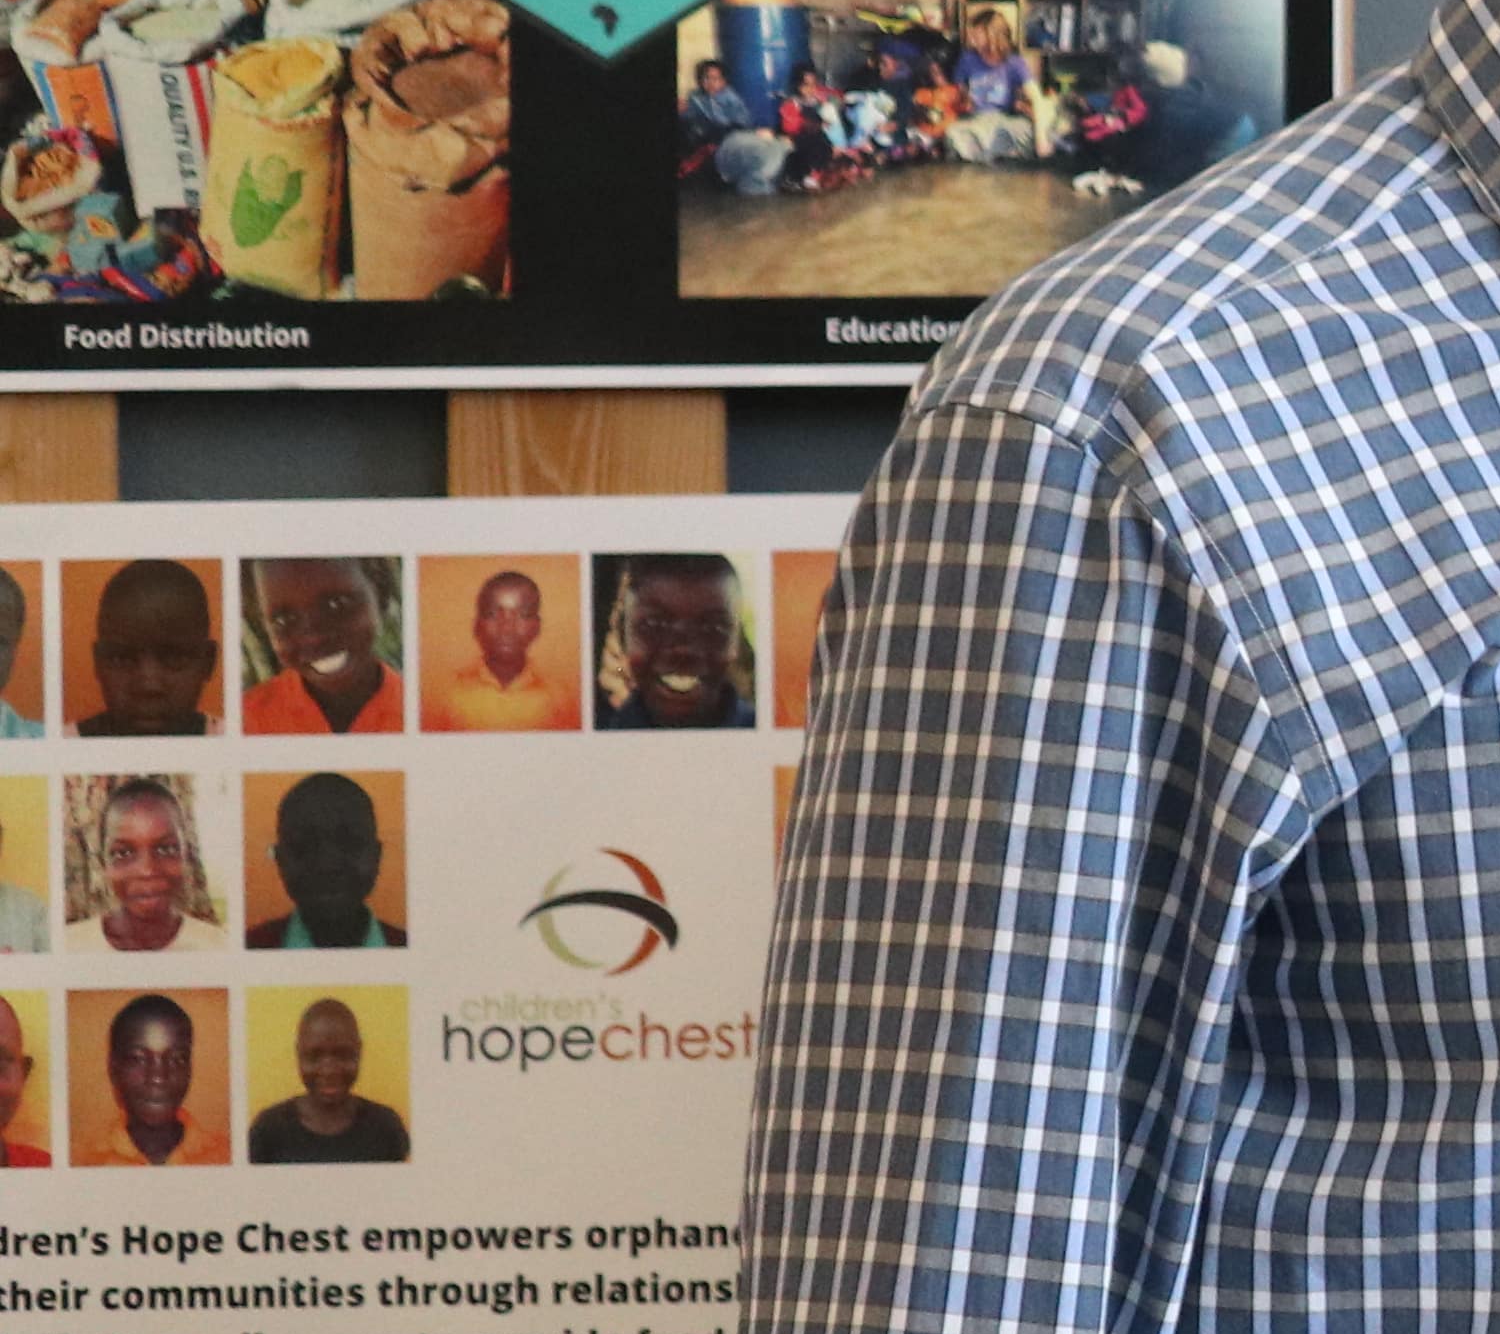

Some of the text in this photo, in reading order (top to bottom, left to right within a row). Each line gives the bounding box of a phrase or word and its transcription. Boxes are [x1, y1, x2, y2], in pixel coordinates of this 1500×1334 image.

[64, 322, 310, 349] Food Distribution
[459, 992, 625, 1022] children's
[441, 1012, 757, 1072] hopechest
[122, 1225, 224, 1264] Hope
[237, 1222, 349, 1254] Chest
[361, 1226, 573, 1260] empowers
[100, 1276, 365, 1311] communities
[377, 1274, 539, 1315] through
